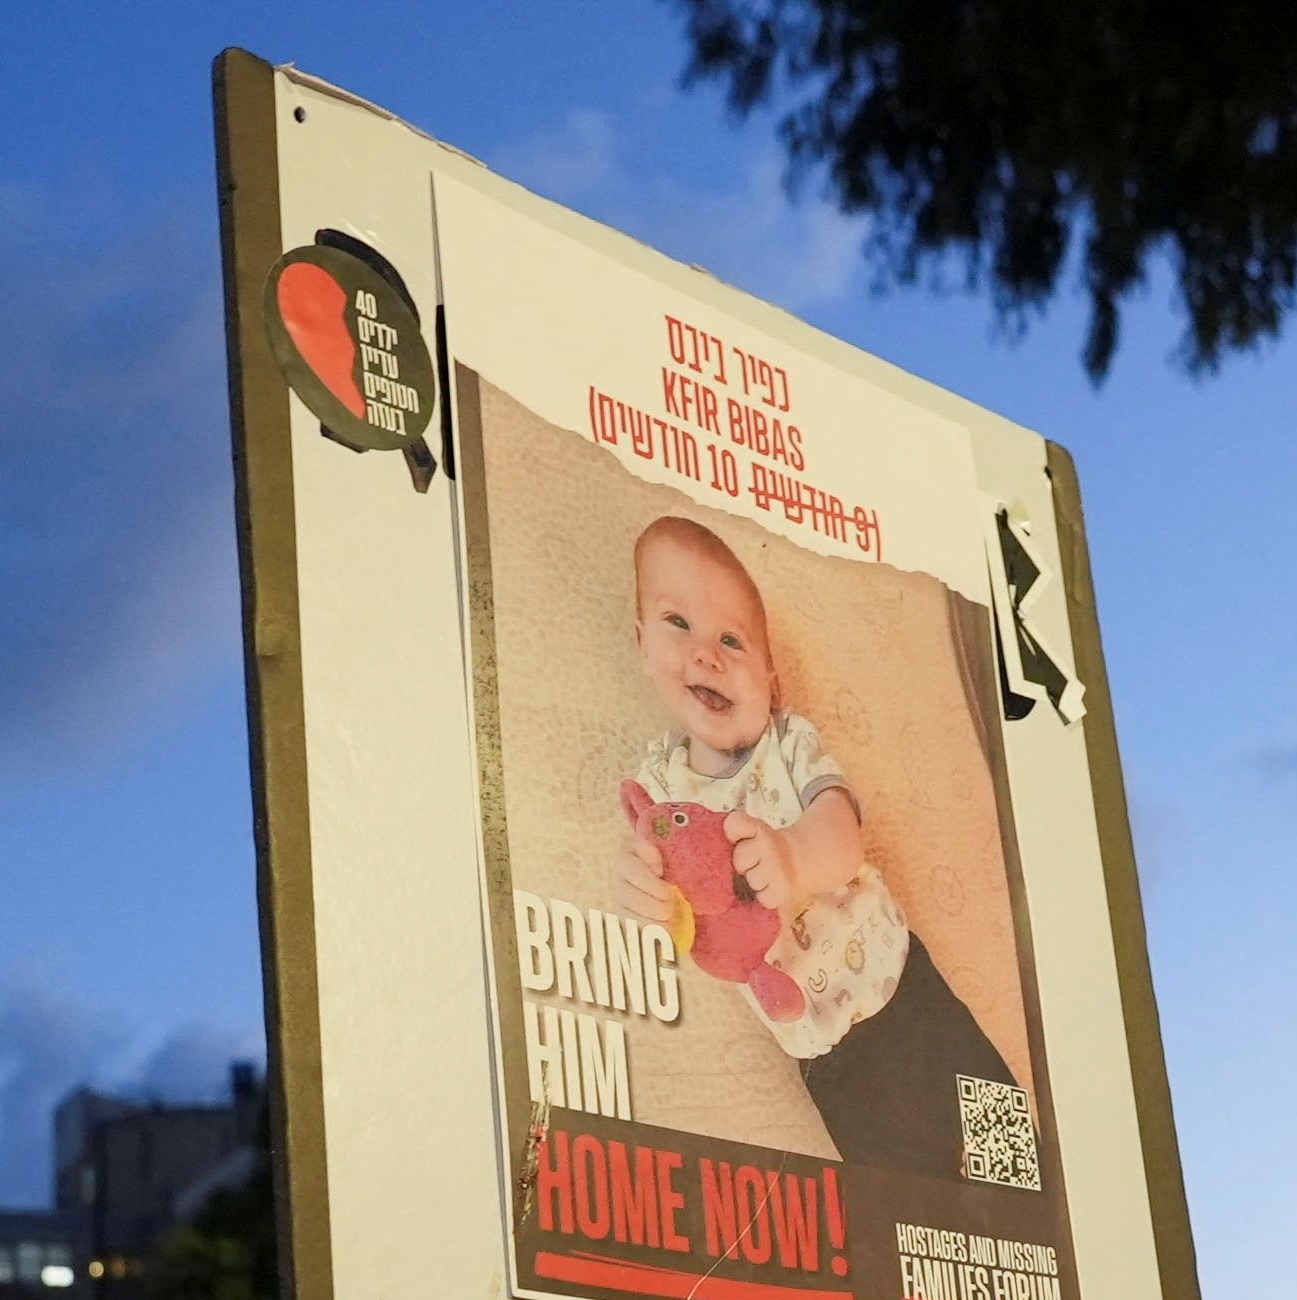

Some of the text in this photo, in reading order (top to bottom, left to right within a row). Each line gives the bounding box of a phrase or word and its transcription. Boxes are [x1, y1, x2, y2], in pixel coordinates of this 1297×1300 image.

[355, 290, 378, 318] 40
[357, 316, 399, 351] ילדים
[359, 343, 399, 379] עדיין
[664, 314, 790, 412] כפיר ביבס
[363, 371, 420, 414] חטופים
[366, 399, 407, 436] בעזה
[662, 366, 804, 472] KFIR BIBAS
[707, 443, 739, 498] 10
[513, 888, 680, 1023] BRING
[525, 1001, 632, 1122] HIM
[536, 1129, 848, 1277] HOME NOW!
[896, 1222, 1058, 1276] HOSTAGES AND MISSING
